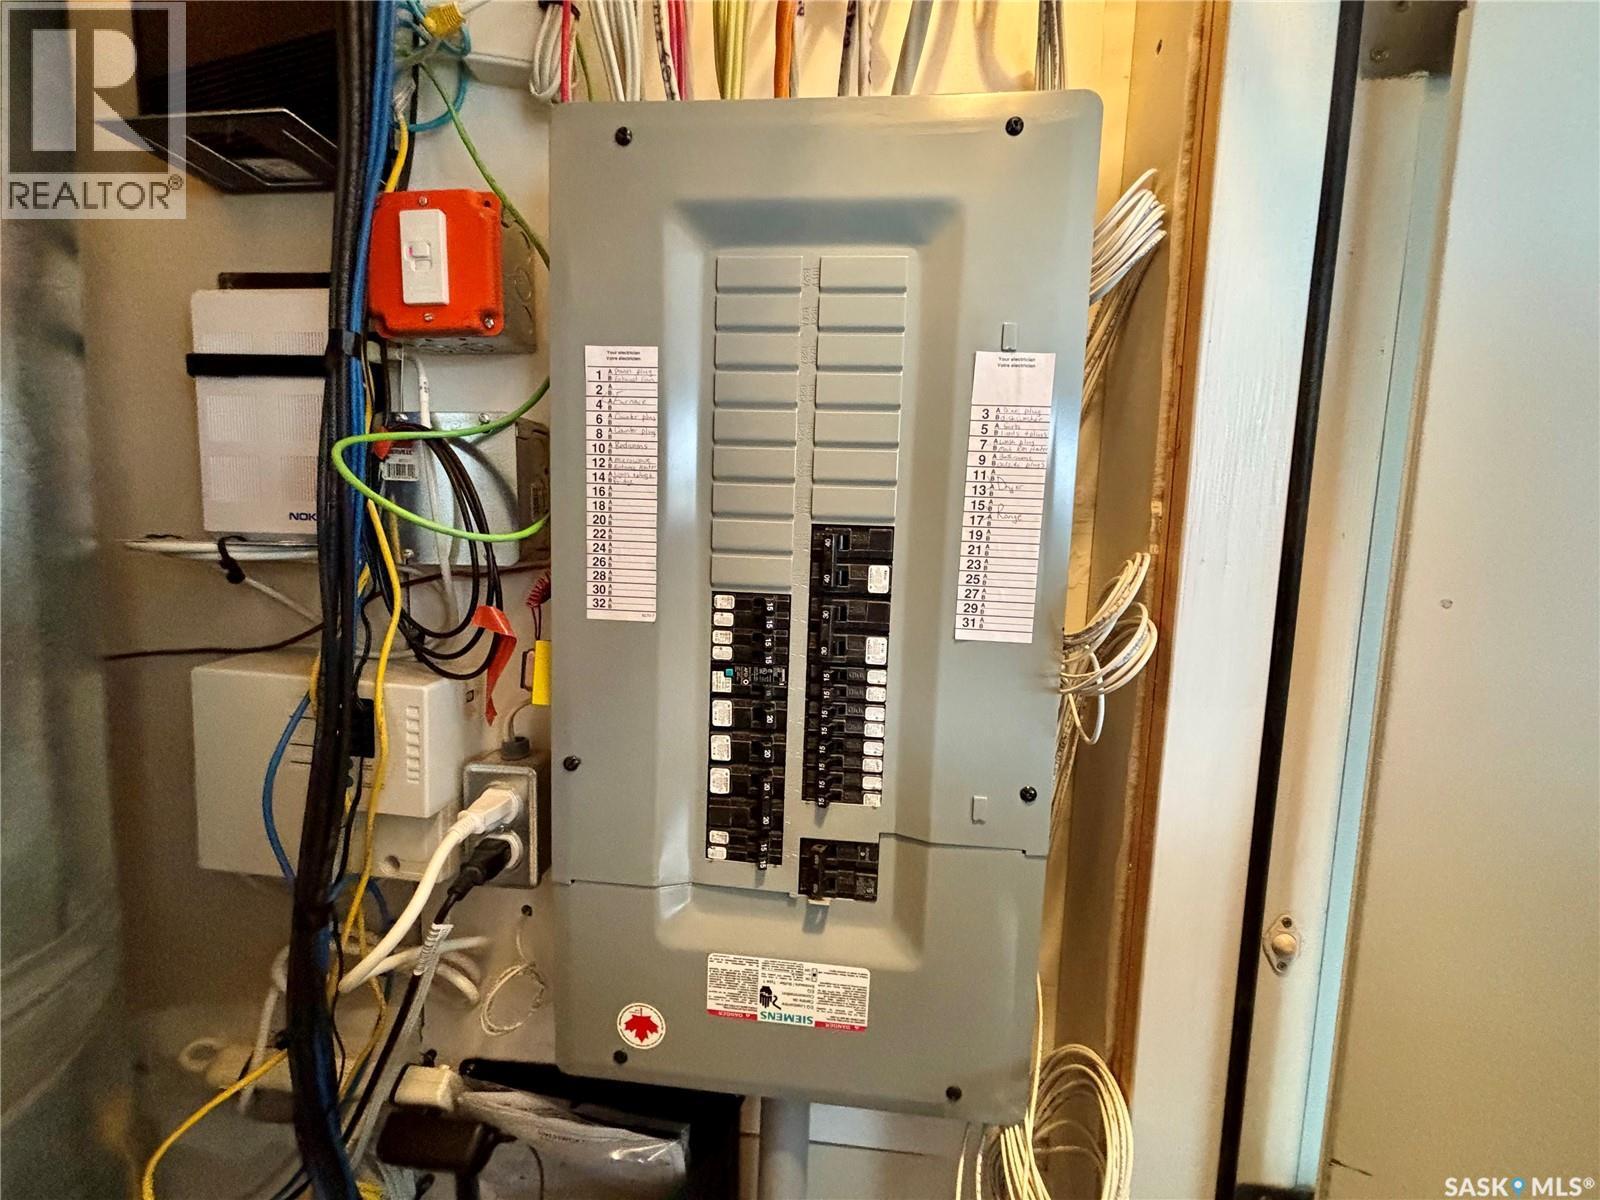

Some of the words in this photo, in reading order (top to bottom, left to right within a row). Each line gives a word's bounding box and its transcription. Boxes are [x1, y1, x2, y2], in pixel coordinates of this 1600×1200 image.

[596, 370, 601, 380] 1
[596, 385, 603, 395] 2
[596, 399, 603, 410] 4
[982, 408, 989, 419] 3
[596, 414, 603, 424] 6
[596, 428, 603, 439] 8
[981, 424, 988, 434] 5
[592, 443, 606, 453] 10
[980, 439, 987, 449] 7
[592, 457, 606, 468] 12
[978, 455, 986, 465] 9
[592, 472, 606, 482] 14
[973, 470, 986, 480] 11
[592, 486, 606, 496] 16
[972, 485, 986, 495] 13
[592, 500, 606, 511] 18
[971, 500, 985, 510] 15
[289, 512, 318, 521] NOK
[592, 514, 606, 525] 20
[970, 515, 984, 525] 17
[592, 528, 606, 539] 22
[969, 530, 983, 540] 19
[592, 542, 606, 553] 24
[824, 538, 832, 547] 40
[967, 544, 981, 555] 21
[592, 556, 606, 567] 26
[966, 559, 981, 569] 23
[592, 570, 606, 581] 28
[823, 574, 831, 583] 40
[965, 574, 980, 584] 25
[592, 584, 606, 594] 30
[964, 588, 980, 599] 27
[592, 598, 606, 608] 32
[766, 602, 773, 611] 15
[963, 603, 978, 613] 29
[822, 610, 830, 619] 30
[766, 620, 773, 629] 15
[962, 617, 975, 628] 31
[765, 638, 772, 647] 15
[820, 646, 828, 655] 30
[765, 655, 772, 664] 15
[823, 673, 830, 681] 15
[823, 690, 830, 699] 15
[821, 710, 828, 718] 15
[766, 715, 773, 724] 20
[821, 727, 828, 735] 15
[763, 749, 771, 758] 20
[819, 745, 826, 754] 15
[819, 763, 825, 771] 15
[763, 783, 770, 791] 20
[819, 780, 825, 788] 15
[818, 797, 825, 806] 15
[762, 816, 770, 825] 20
[760, 843, 767, 851] 15
[759, 860, 767, 868] 15
[760, 1011, 813, 1025] SIEMENS
